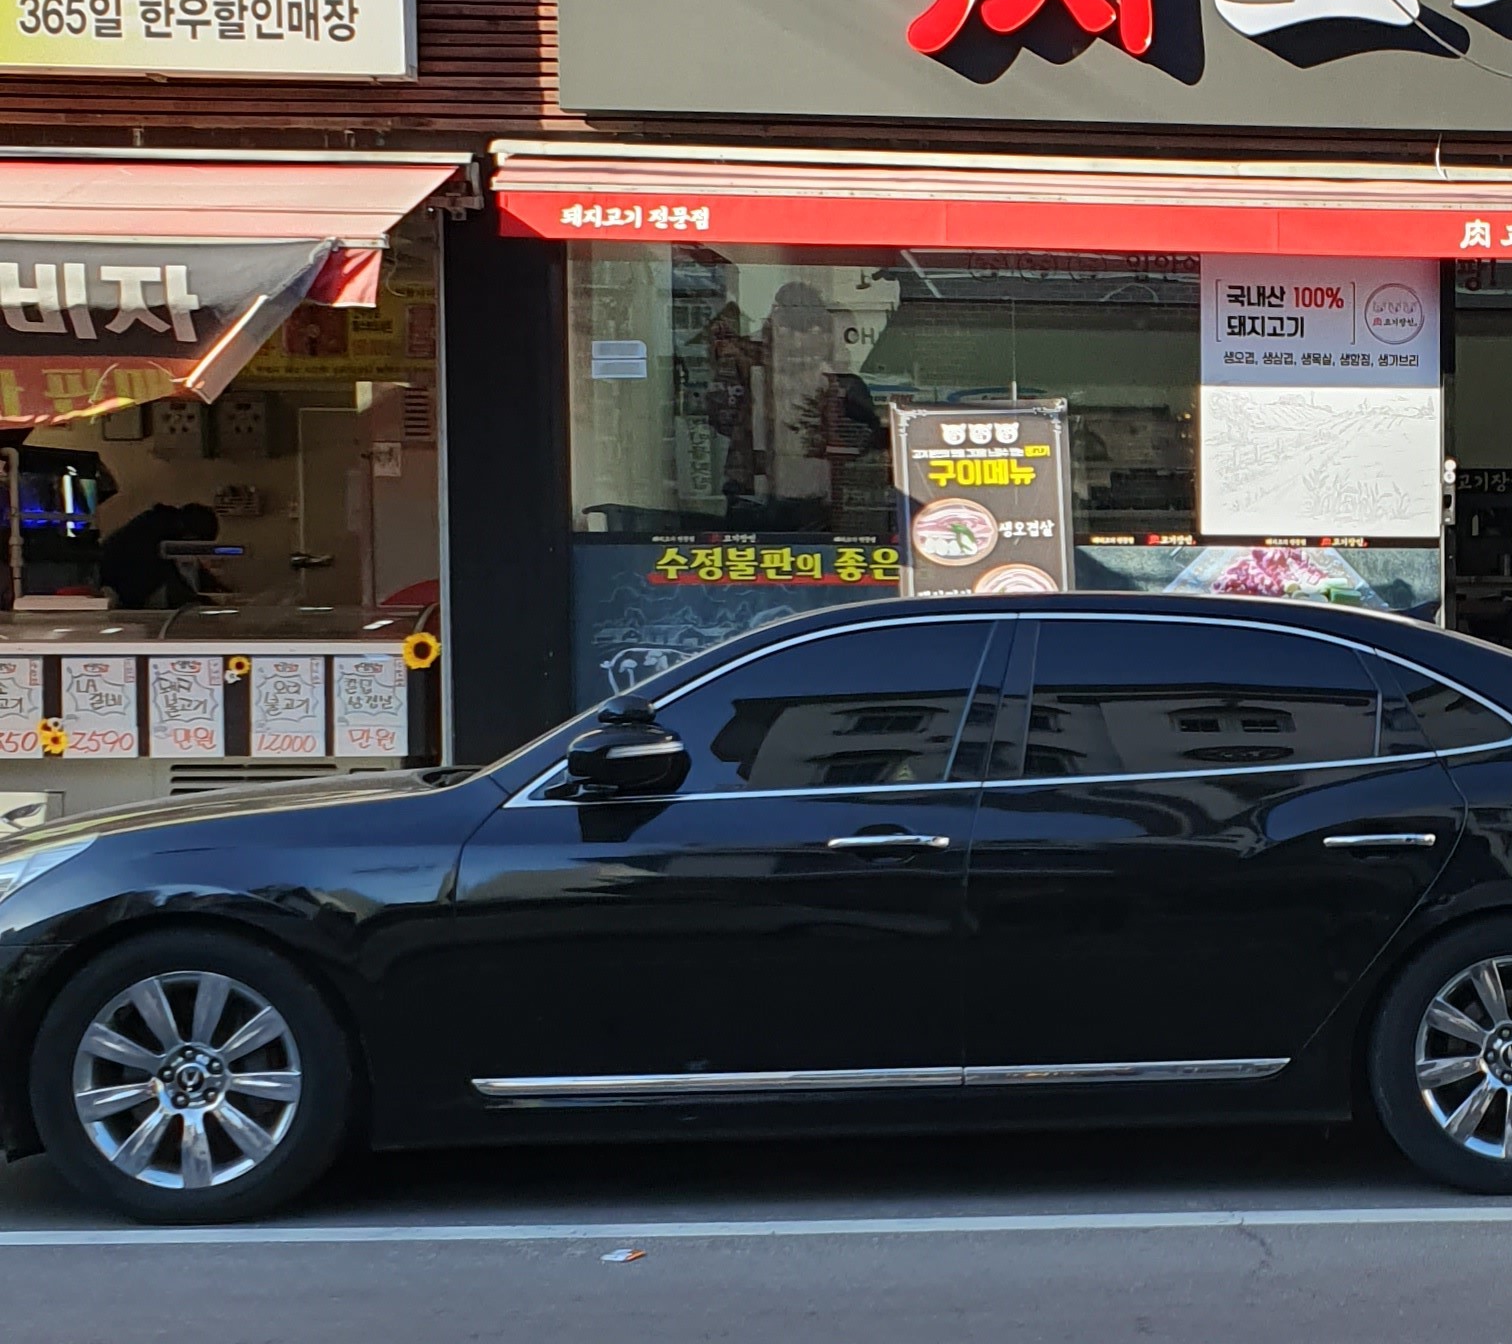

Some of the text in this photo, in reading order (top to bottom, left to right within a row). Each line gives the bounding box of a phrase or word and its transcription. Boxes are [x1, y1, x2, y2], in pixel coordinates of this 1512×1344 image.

[560, 203, 711, 231] 돼지고기 전문점
[1226, 285, 1345, 310] 국내산 100%
[1226, 315, 1305, 338] 돼지고기
[928, 459, 1036, 487] 구이메뉴
[656, 546, 900, 581] 수정불판의 좋은
[76, 679, 98, 693] LA
